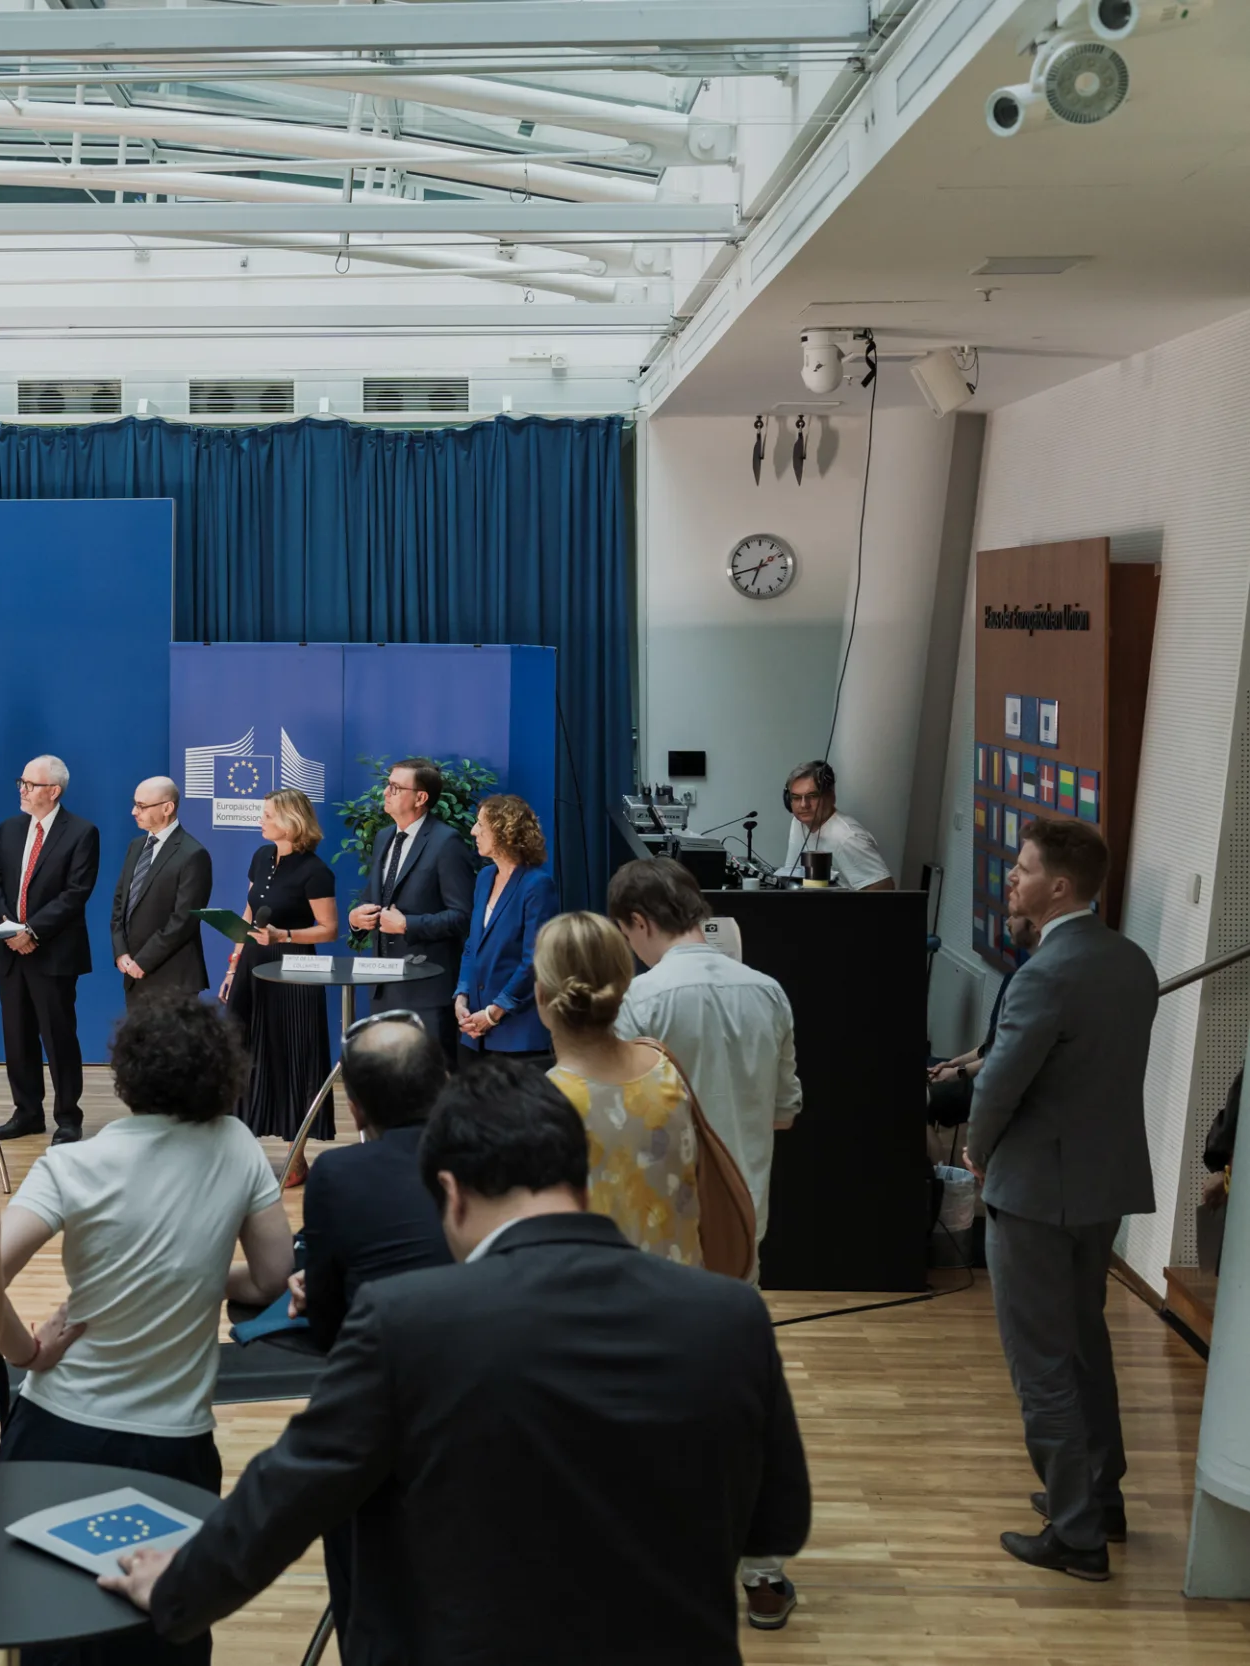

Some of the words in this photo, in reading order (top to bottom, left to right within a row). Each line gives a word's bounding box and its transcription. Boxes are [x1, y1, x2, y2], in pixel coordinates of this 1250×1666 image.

[985, 605, 1001, 629] Haus
[1002, 604, 1013, 629] der
[1014, 602, 1063, 637] Europäischen
[1064, 602, 1090, 631] Union
[216, 801, 262, 812] Europäische
